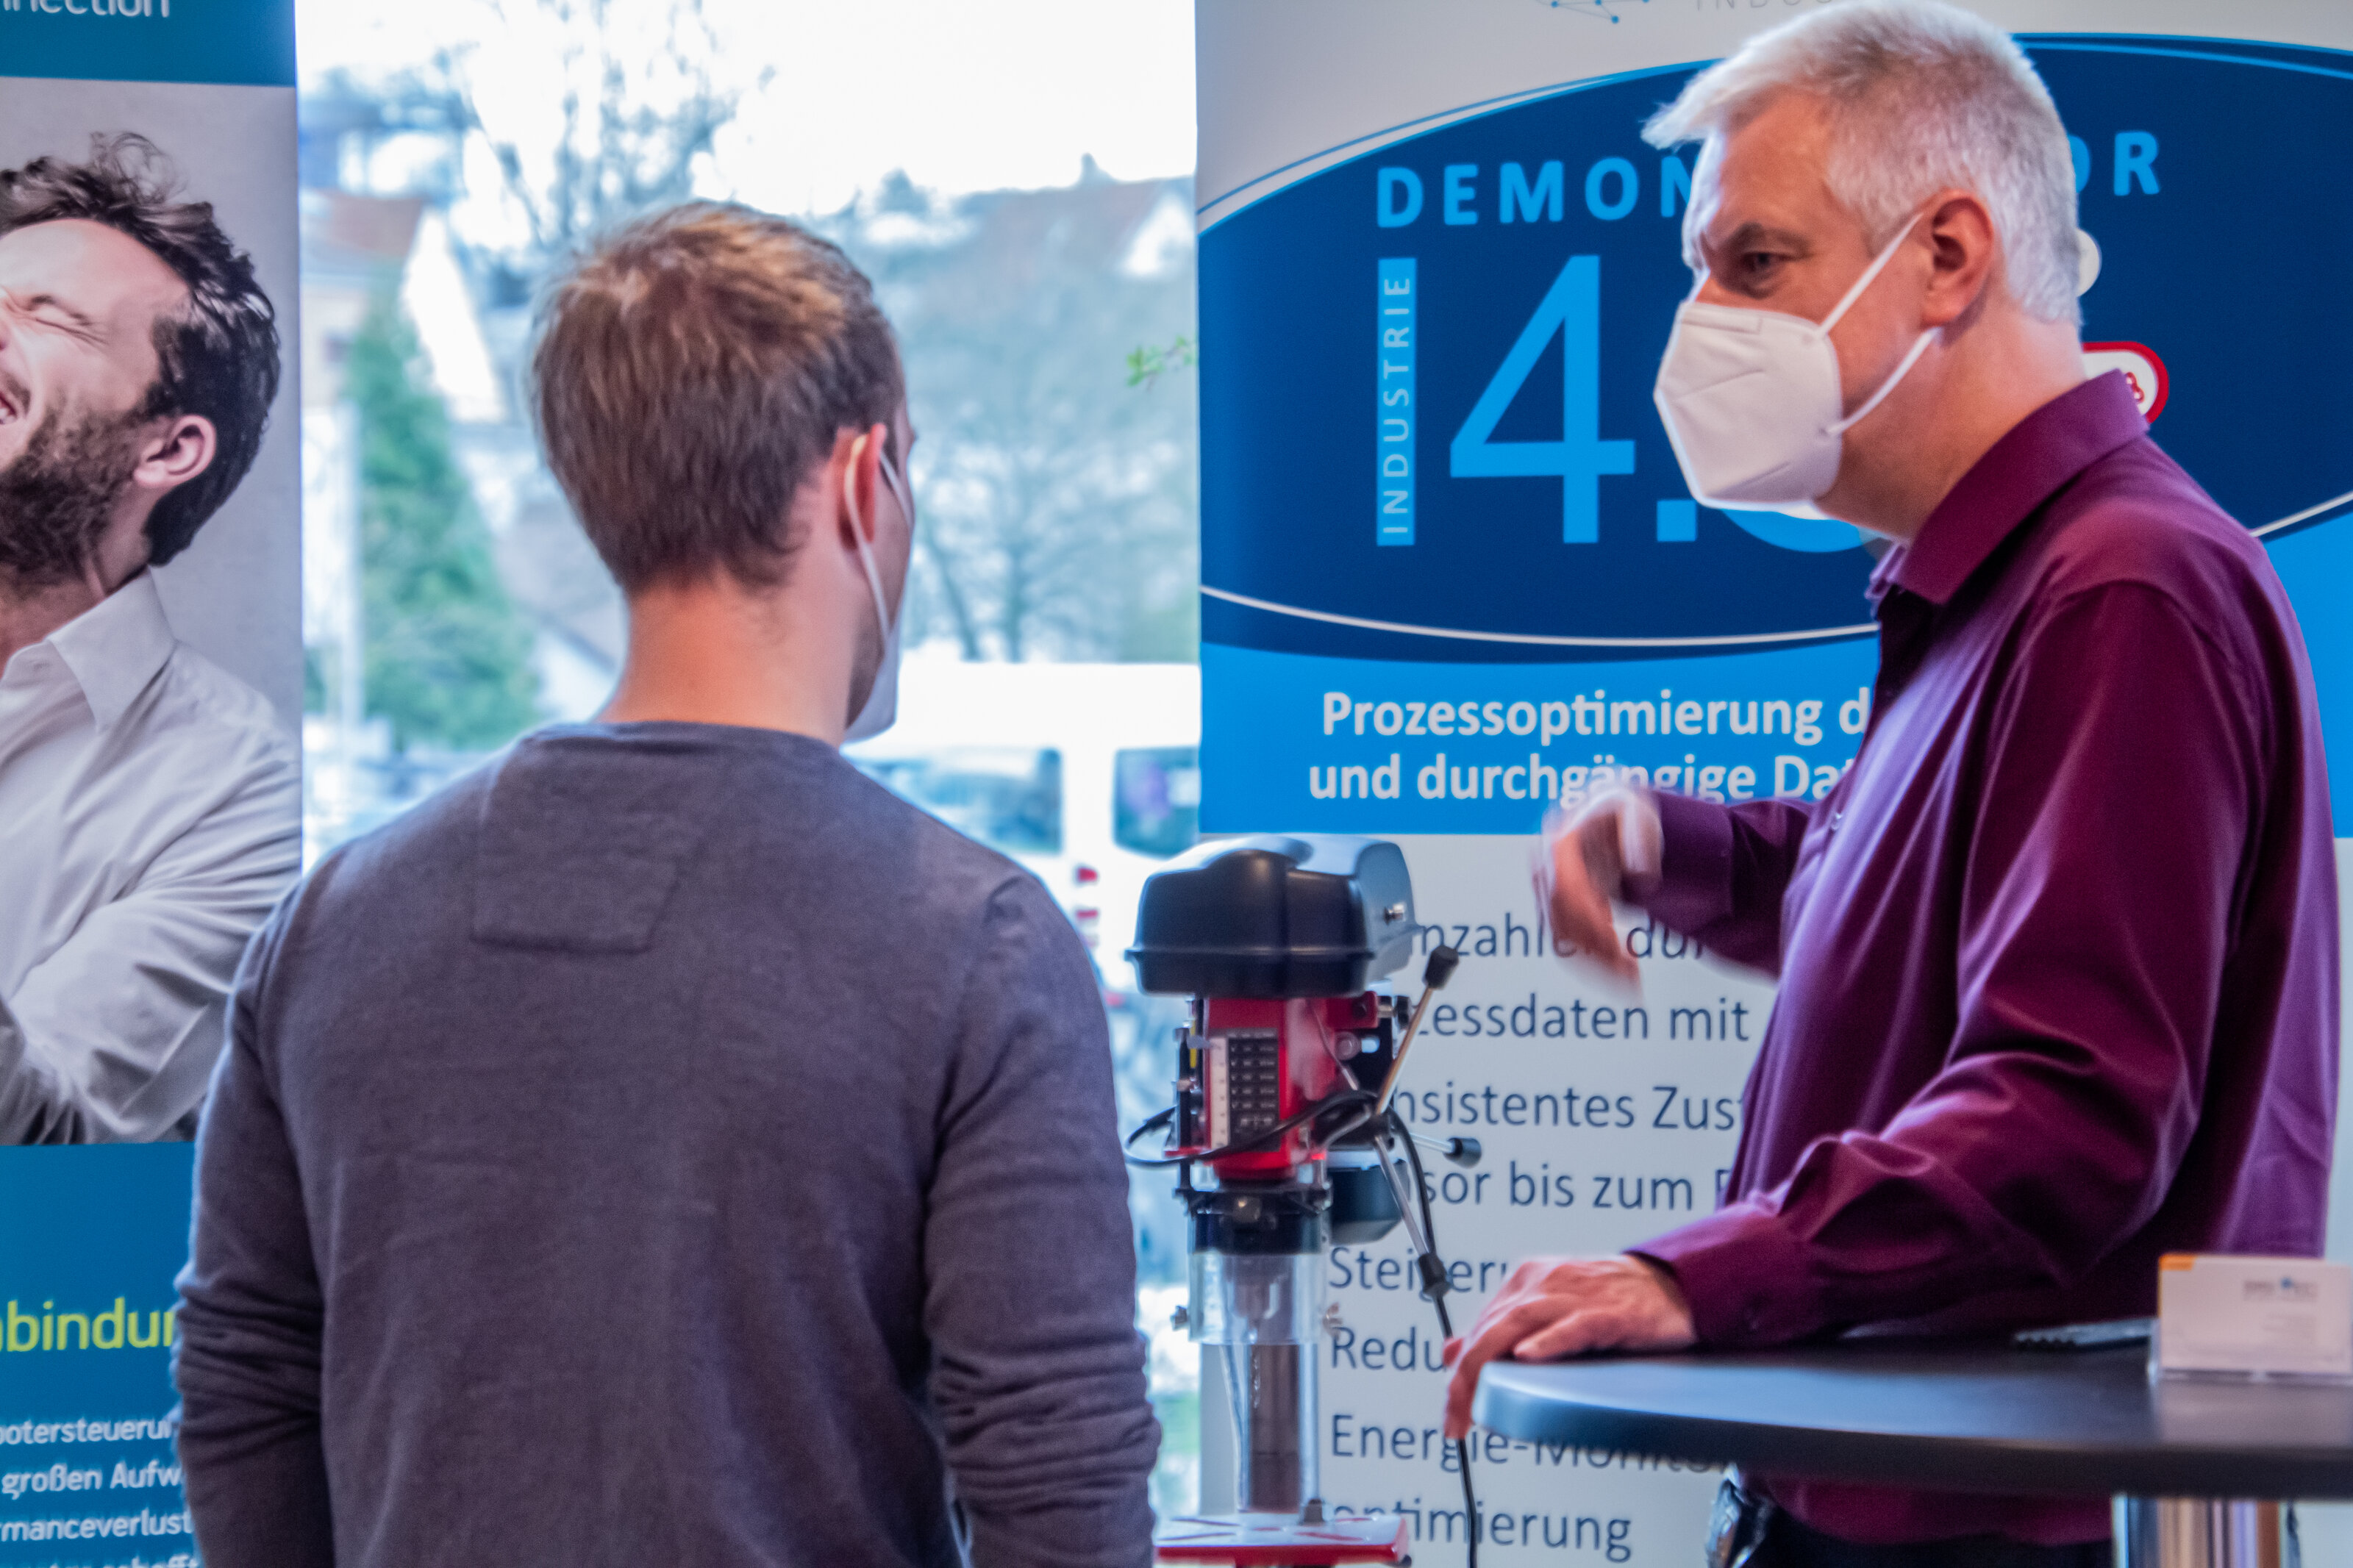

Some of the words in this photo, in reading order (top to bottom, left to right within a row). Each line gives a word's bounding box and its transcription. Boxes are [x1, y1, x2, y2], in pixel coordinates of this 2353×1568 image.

[1383, 276, 1410, 535] INDUSTRIE
[1450, 254, 1868, 553] 4.
[1324, 690, 1823, 746] Prozessoptimierung
[1310, 753, 1400, 798] und
[1418, 753, 1756, 809] durchgängige
[1774, 755, 1854, 800] Da
[1421, 912, 1590, 959] nzahl
[1418, 993, 1649, 1039] essdaten
[1670, 998, 1749, 1041] mit
[1652, 1086, 1743, 1131] Zus
[1510, 1161, 1574, 1207] bis
[1592, 1176, 1693, 1210] zum
[1329, 1247, 1507, 1302] Steier
[0, 1297, 174, 1352] bindu
[1332, 1326, 1446, 1372] Redu
[0, 1418, 171, 1445] otersteueru
[1, 1463, 102, 1500] großen
[0, 1508, 193, 1542] manceverlust
[1335, 1497, 1632, 1563] imierung
